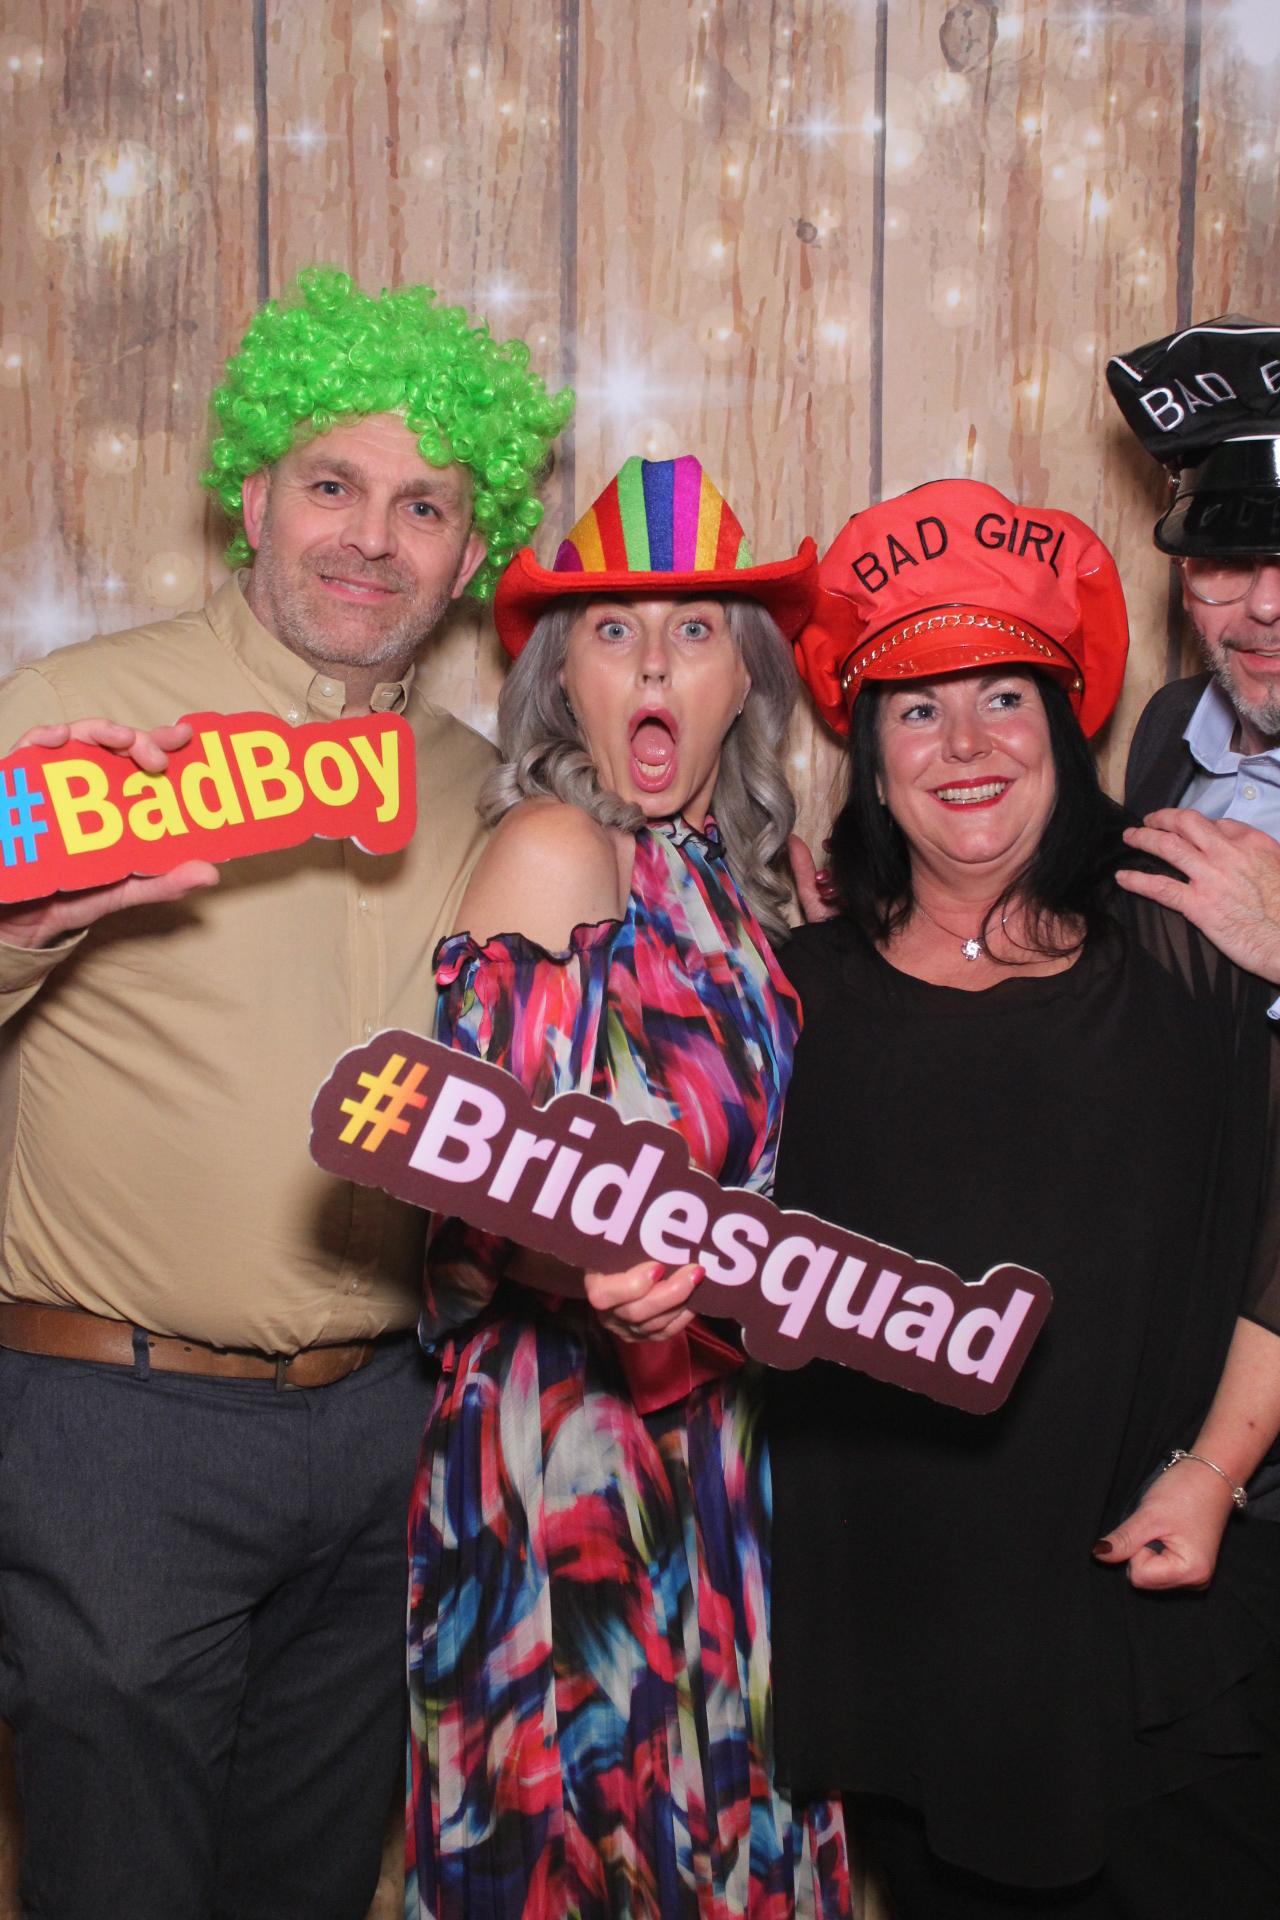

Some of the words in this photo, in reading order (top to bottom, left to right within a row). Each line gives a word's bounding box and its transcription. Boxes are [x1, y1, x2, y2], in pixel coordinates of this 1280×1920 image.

[1139, 372, 1237, 432] BAD
[851, 516, 948, 594] BAD
[974, 513, 1065, 578] GIRL
[0, 730, 401, 867] #BadBoy
[337, 1053, 1036, 1384] #Bridesquad
